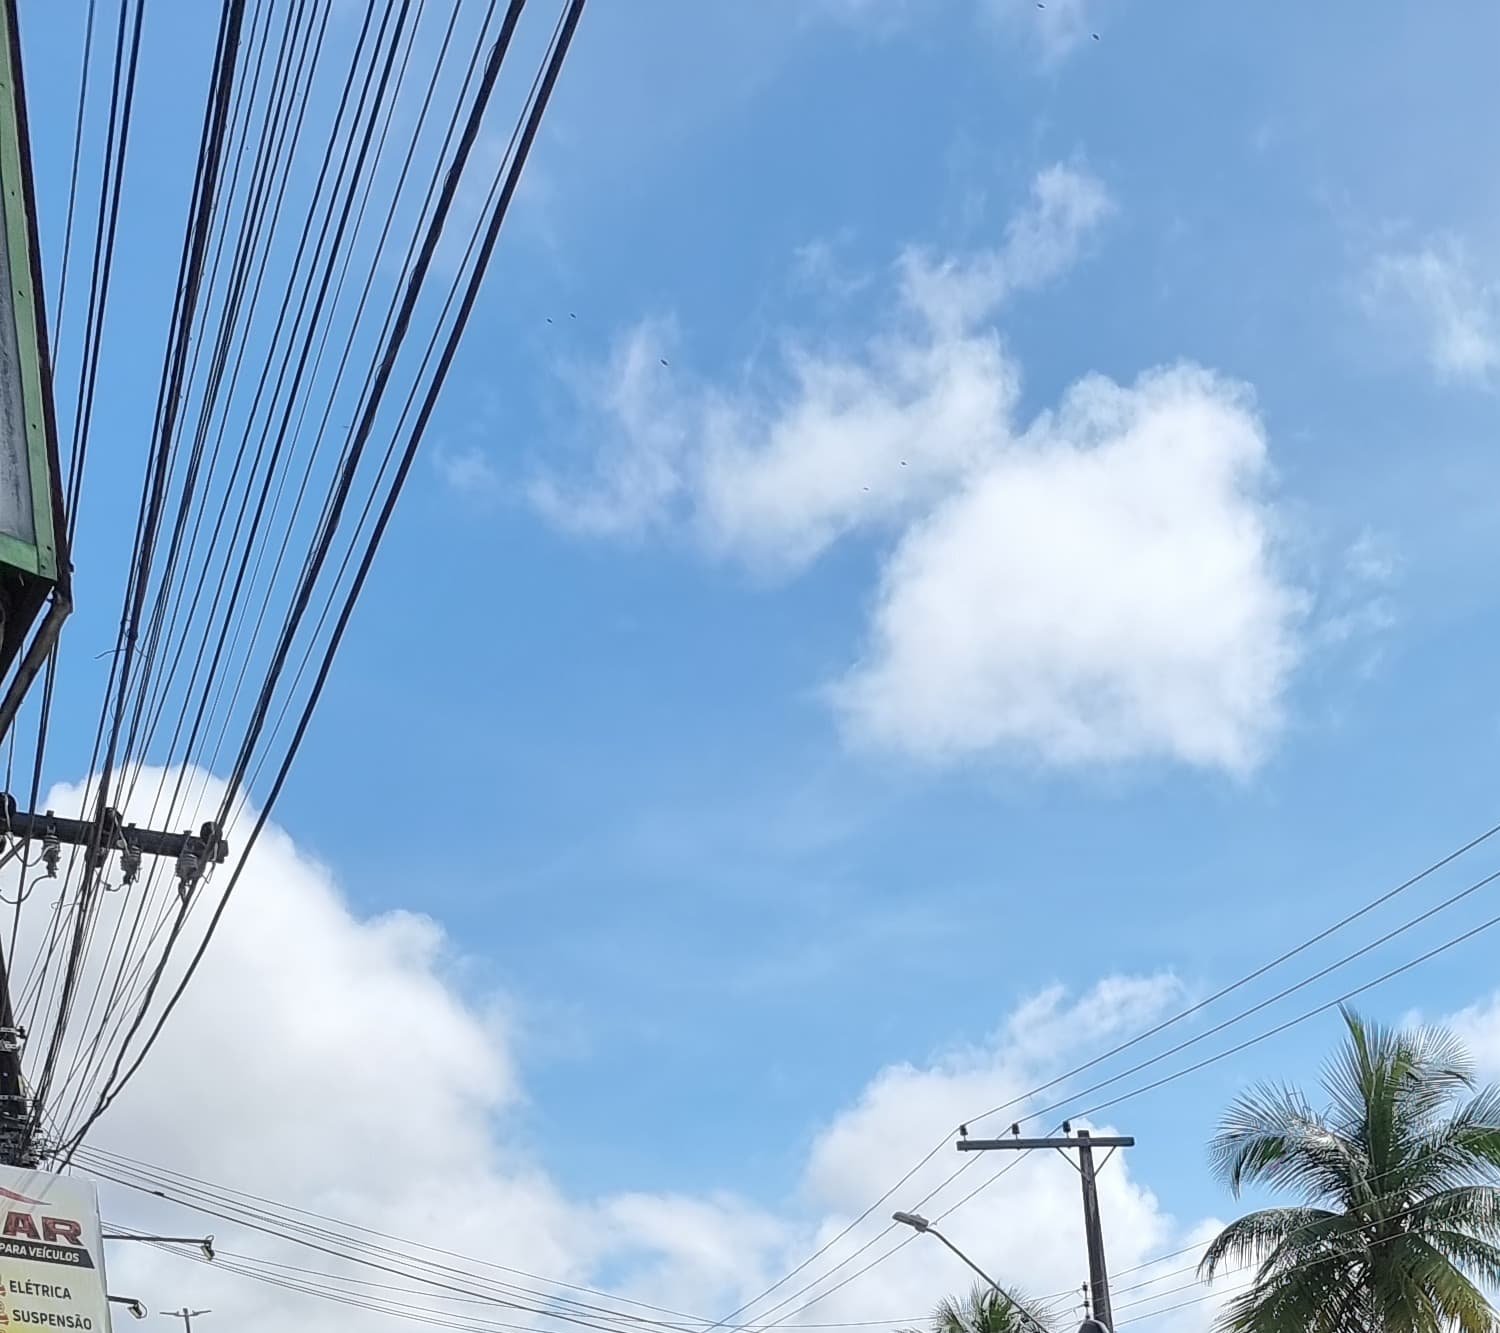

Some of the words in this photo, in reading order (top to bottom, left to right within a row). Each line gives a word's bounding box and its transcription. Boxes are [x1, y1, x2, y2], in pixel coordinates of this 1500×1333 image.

[0, 1242, 27, 1256] PARA
[28, 1246, 80, 1263] VEÍCULOS
[9, 1279, 72, 1300] ELÉTRICA
[12, 1309, 92, 1330] SUSPENSÃO
